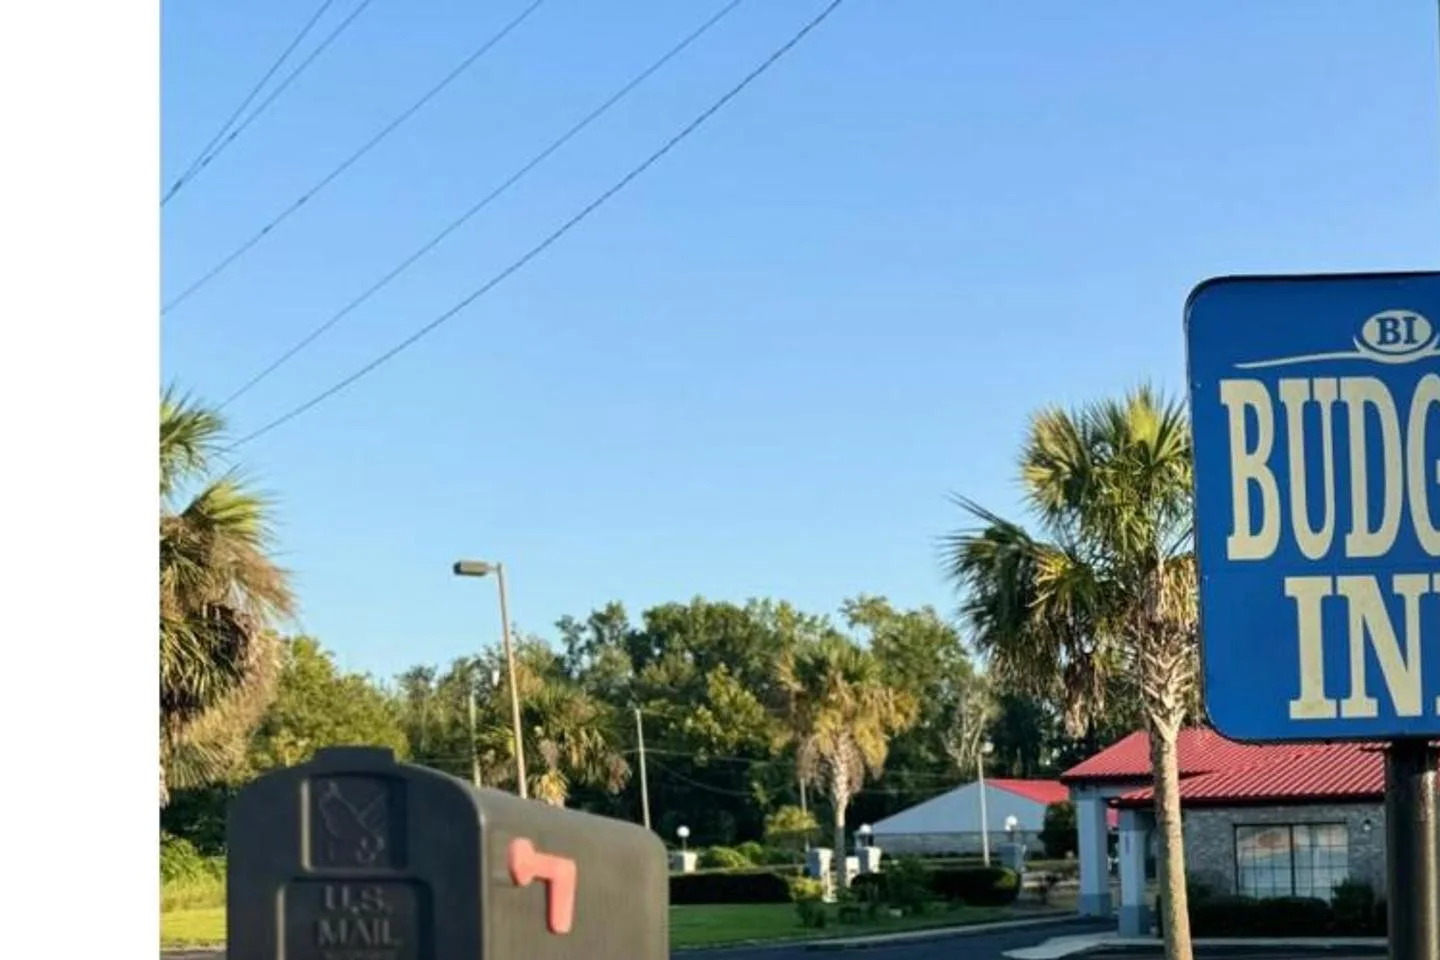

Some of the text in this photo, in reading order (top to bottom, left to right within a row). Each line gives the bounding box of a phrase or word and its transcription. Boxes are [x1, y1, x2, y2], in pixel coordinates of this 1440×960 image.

[1376, 316, 1418, 345] BI
[323, 885, 393, 915] U.S.
[317, 918, 402, 947] MAIL
